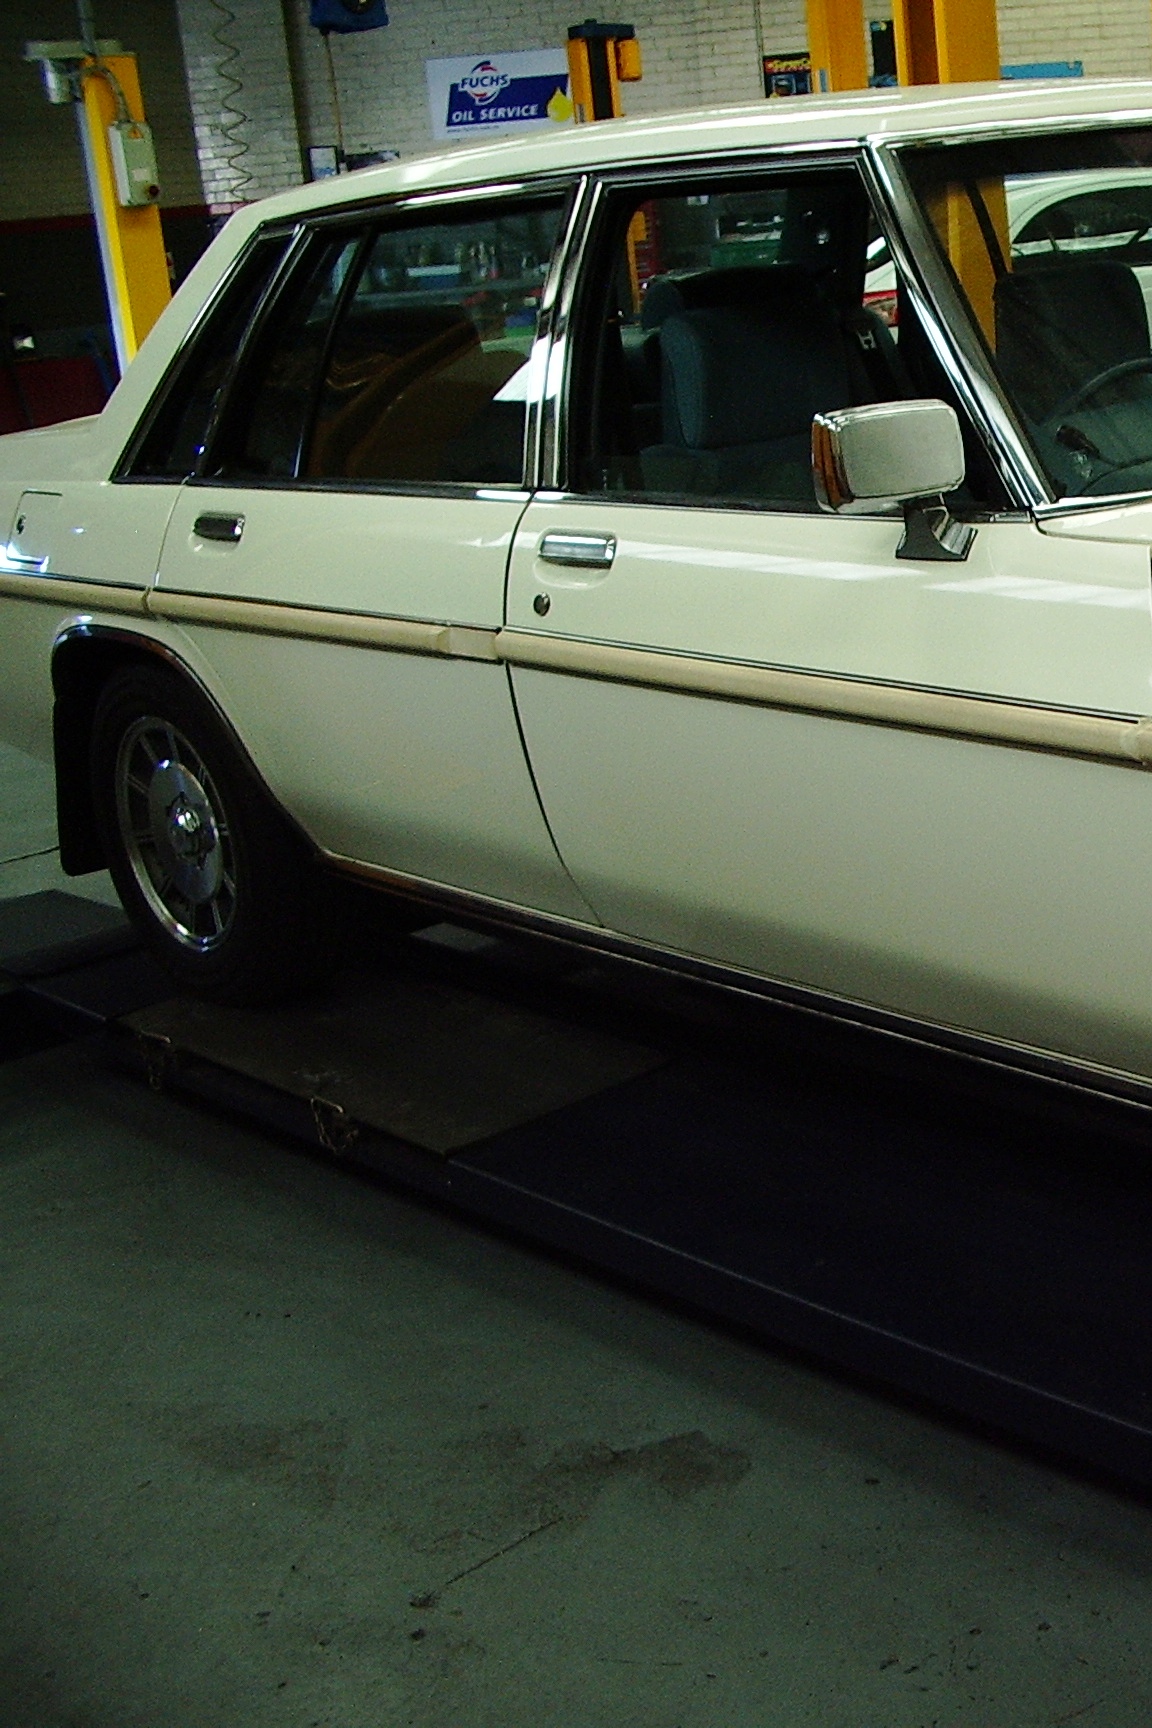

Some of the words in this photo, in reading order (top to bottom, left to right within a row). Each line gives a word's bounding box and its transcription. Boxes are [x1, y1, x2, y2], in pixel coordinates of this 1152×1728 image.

[461, 74, 509, 88] FUCHS
[452, 110, 475, 122] OIL
[480, 104, 539, 120] SERVICE
